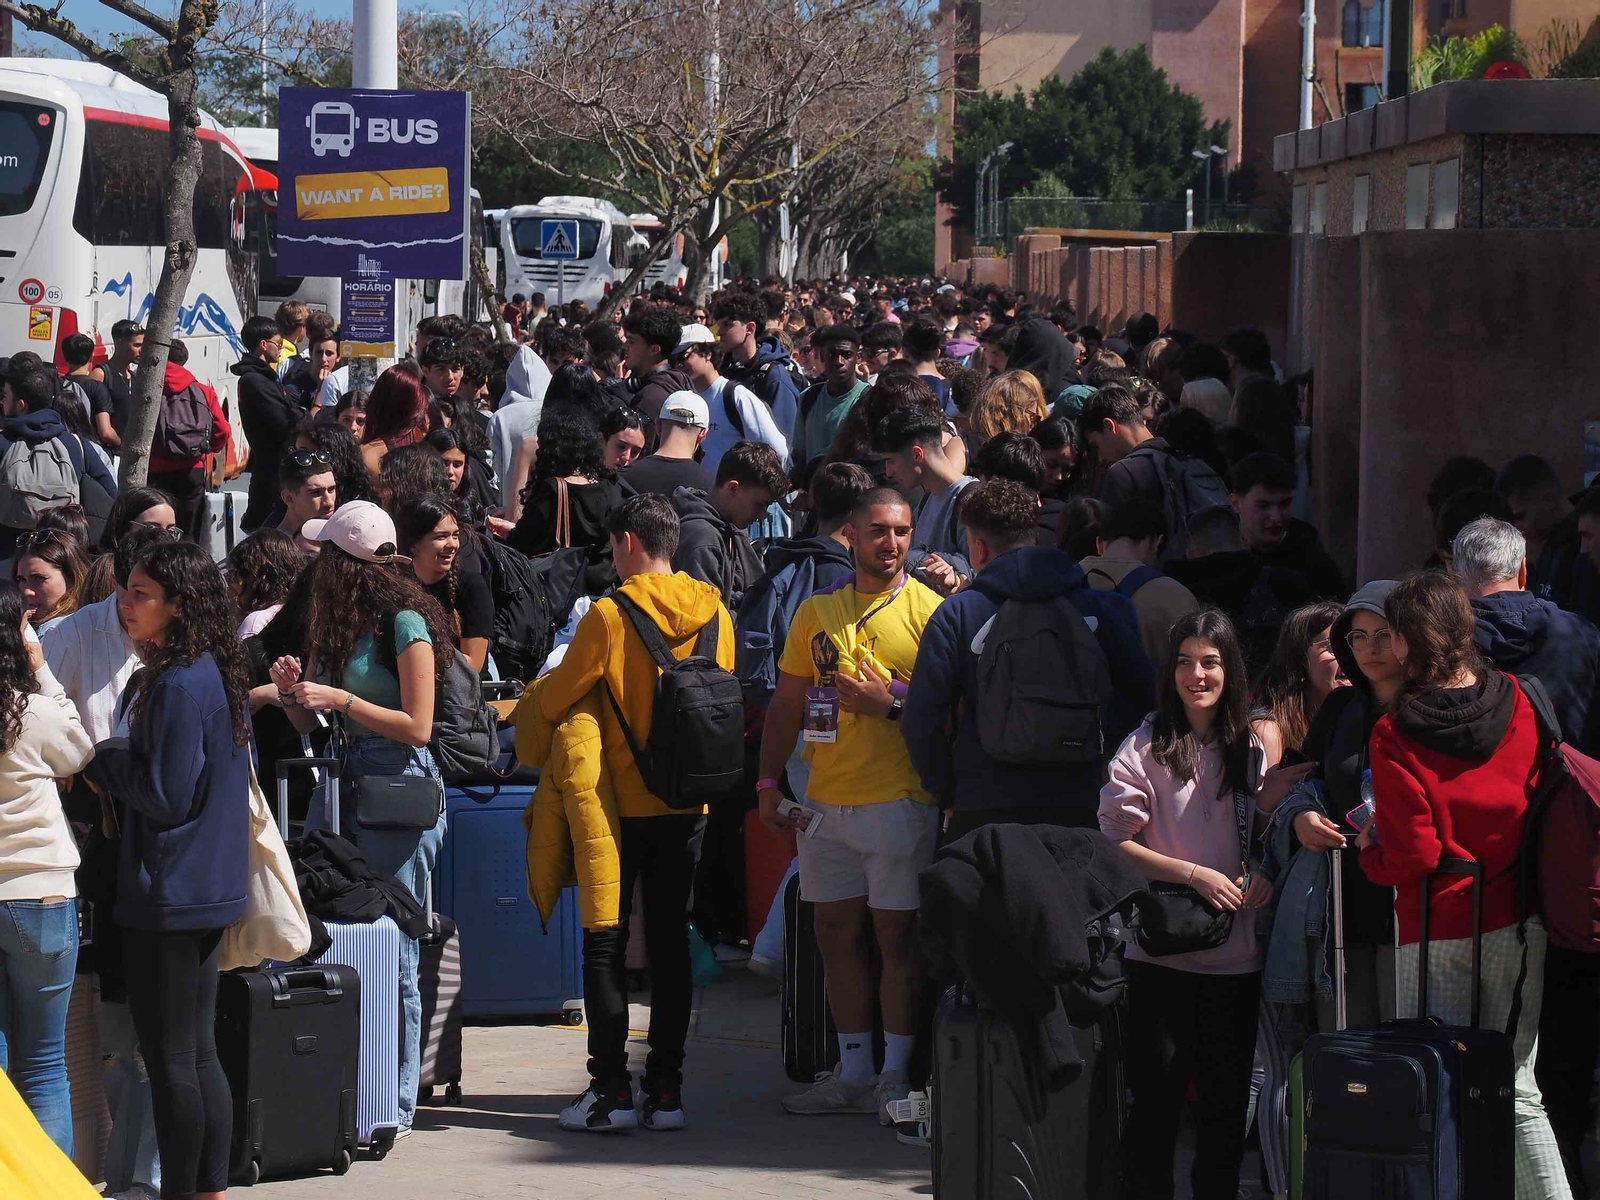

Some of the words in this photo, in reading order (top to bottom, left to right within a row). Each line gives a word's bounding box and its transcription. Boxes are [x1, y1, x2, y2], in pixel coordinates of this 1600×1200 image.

[367, 117, 439, 145] BUS
[301, 188, 364, 206] WANT
[369, 187, 384, 201] A
[389, 184, 445, 201] RIDE?
[24, 286, 39, 297] 100
[344, 281, 392, 292] HORÁRIO
[48, 290, 59, 299] 05
[917, 1101, 926, 1116] CDG
